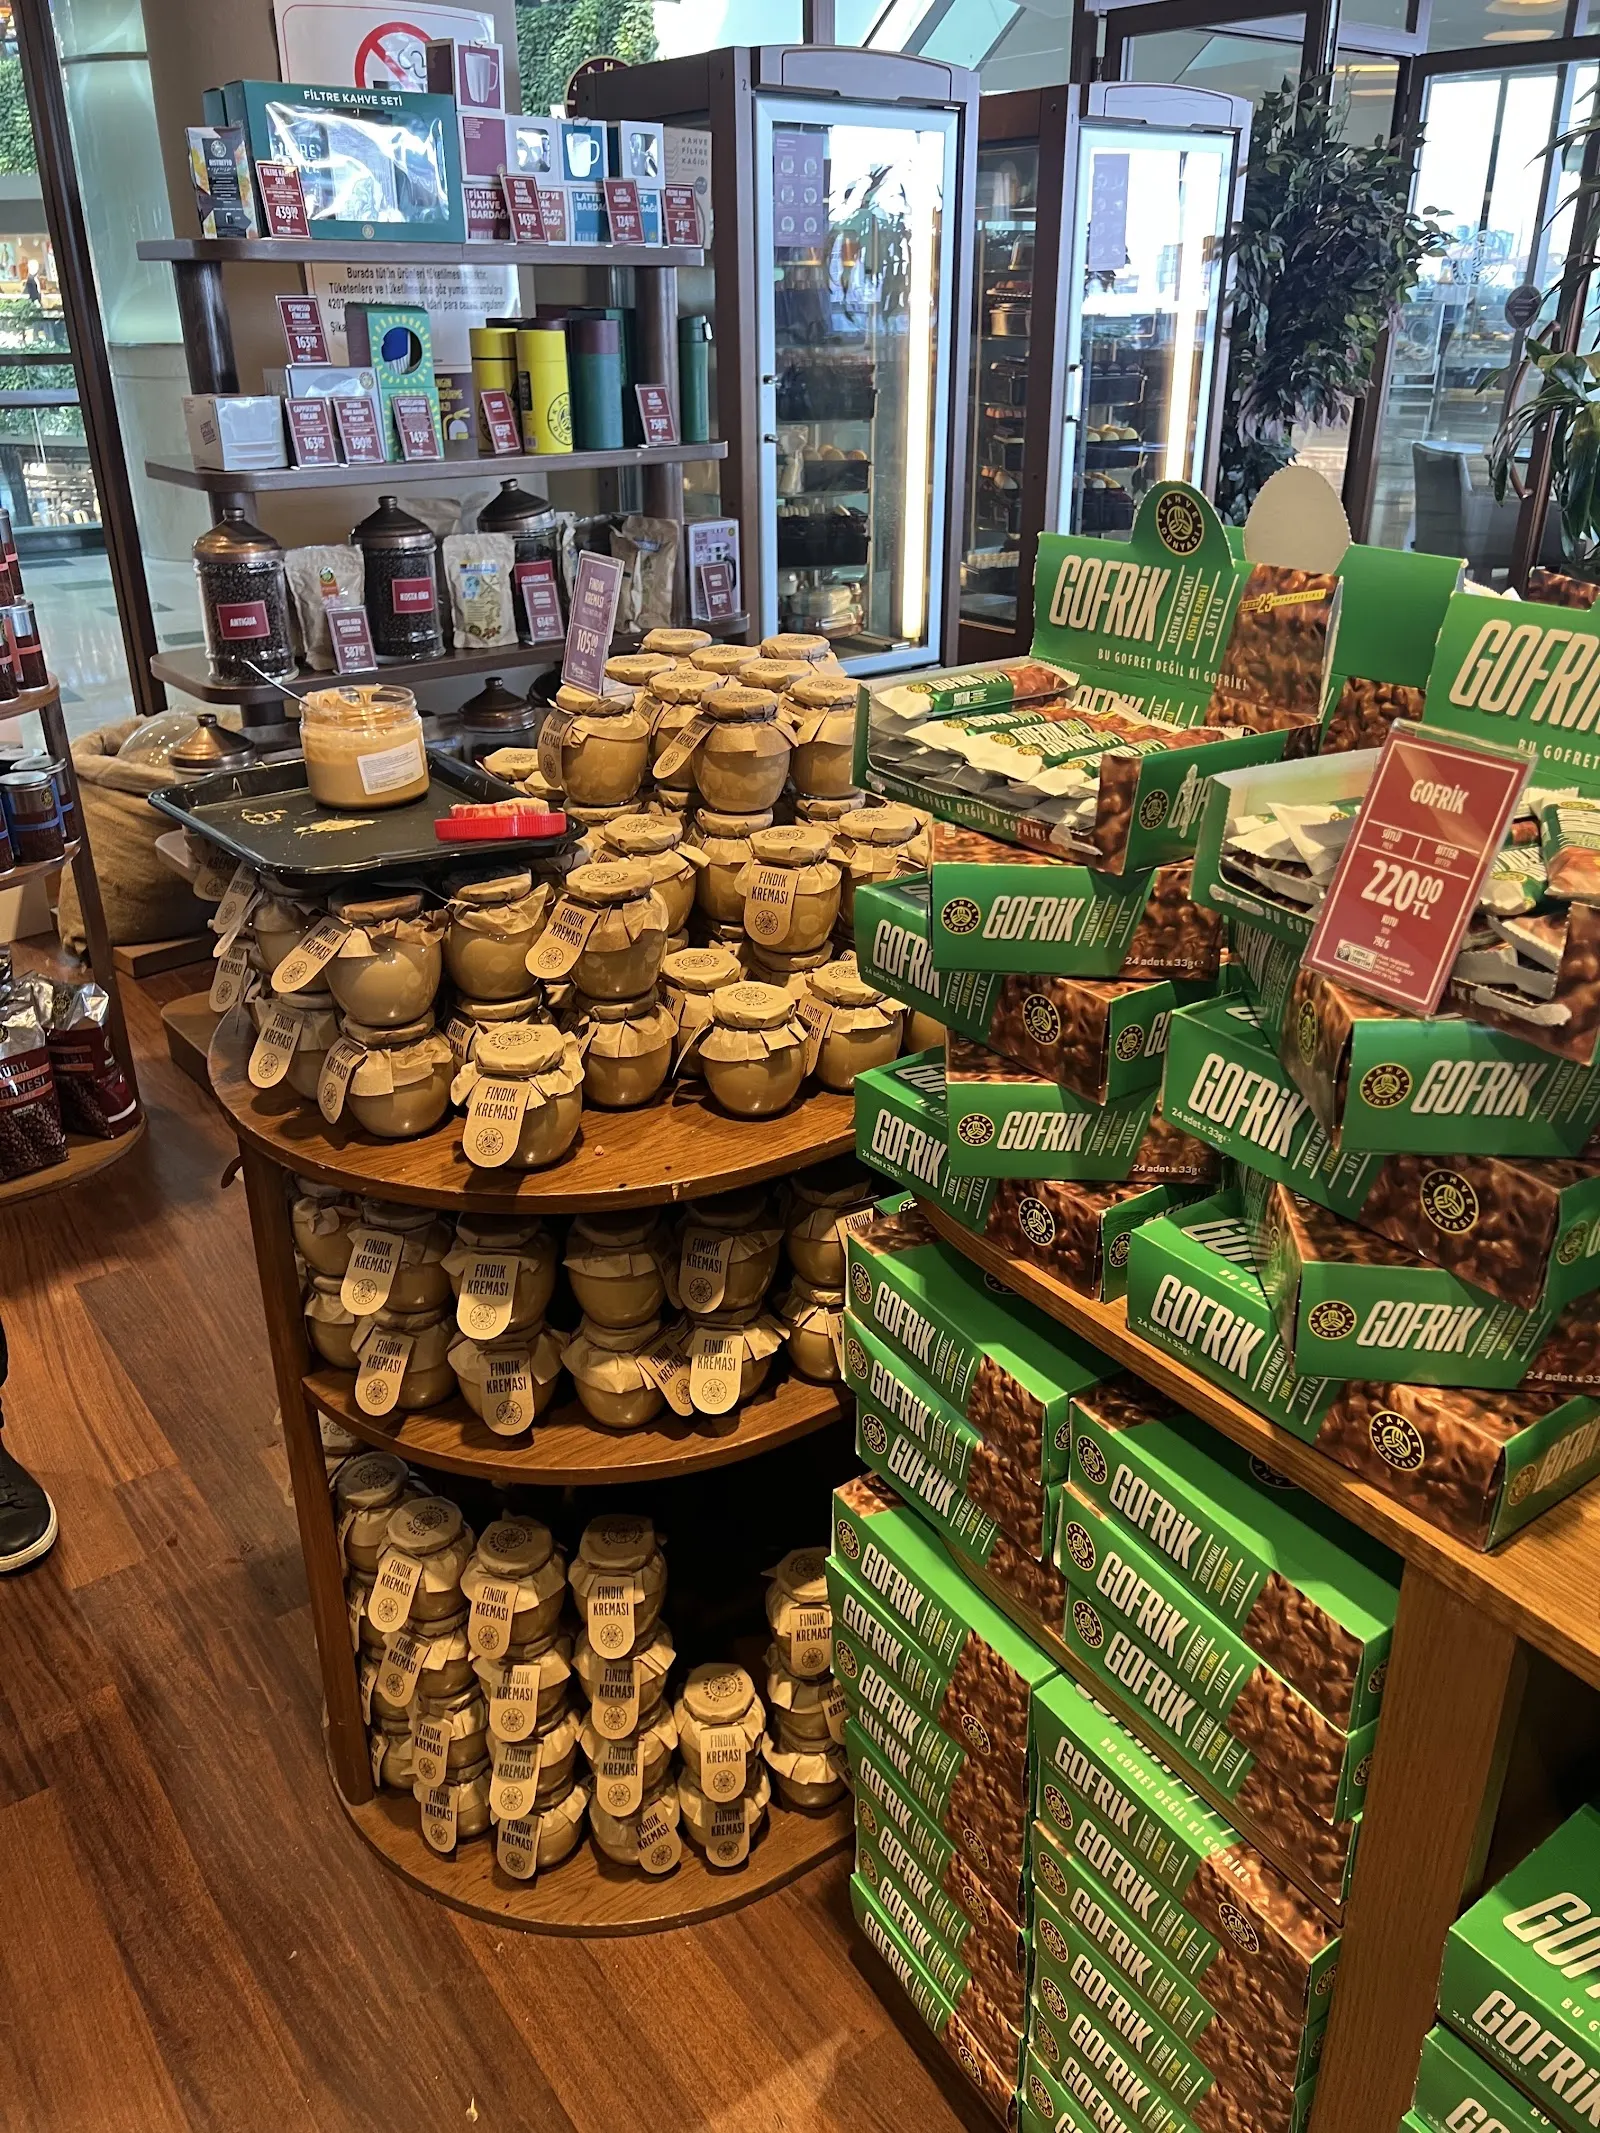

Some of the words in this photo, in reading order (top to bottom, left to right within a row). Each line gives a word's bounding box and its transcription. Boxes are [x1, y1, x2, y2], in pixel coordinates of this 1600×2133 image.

[304, 89, 338, 104] FİLTRE
[341, 92, 379, 105] KAHVE
[380, 94, 403, 107] SETİ
[682, 137, 708, 145] KAHVE
[682, 158, 708, 166] KAĞIDI
[469, 189, 497, 199] FİLTRE
[275, 205, 291, 219] 439
[518, 213, 531, 225] 143
[616, 215, 628, 227] 124
[347, 267, 373, 278] Burada
[329, 283, 372, 294] Tüketenlere
[376, 286, 383, 294] ve
[295, 336, 311, 349] 163
[303, 437, 318, 449] 163
[409, 432, 422, 443] 143
[1159, 495, 1198, 518] KAHVE
[1161, 526, 1198, 551] DÜNYASI
[1049, 555, 1171, 642] GOFRİK
[1257, 592, 1274, 613] 23
[1167, 614, 1181, 644] FISTIK
[1174, 575, 1195, 617] PARÇALI
[1186, 614, 1199, 642] FISTIK
[1195, 585, 1209, 614] EZMELİ
[1205, 598, 1225, 637] SÜTLÜ
[577, 629, 591, 653] 105
[1098, 648, 1111, 662] BU
[1115, 651, 1152, 670] GOFRET
[1156, 659, 1184, 677] DEĞİL
[1189, 667, 1201, 681] Kİ
[1204, 668, 1248, 691] GOFRİK!
[1517, 738, 1536, 756] BU
[1409, 779, 1469, 814] GOFRİK
[917, 789, 951, 811] GOFRET
[956, 803, 984, 822] DEĞİL
[989, 812, 999, 826] Kİ
[1004, 817, 1047, 842] GOFRİK!
[1381, 828, 1402, 843] SÜTLÜ
[758, 871, 788, 888] FINDIK
[1361, 859, 1420, 911] 220
[751, 887, 789, 905] KREMASI
[981, 895, 1086, 942] GOFRİK
[1381, 914, 1399, 927] KUTU
[1413, 901, 1432, 920] TL
[551, 922, 583, 948] KREMASI
[300, 937, 332, 962] KREMASI
[1125, 956, 1139, 966] 24
[1141, 958, 1165, 967] adet
[262, 1028, 293, 1050] KREMASI
[484, 1086, 518, 1102] FINDIK
[1411, 1059, 1548, 1116] GOFRİK
[474, 1102, 519, 1120] KREMASI
[1171, 1107, 1185, 1119] 24
[1187, 1052, 1308, 1158] GOFRİK
[996, 1111, 1093, 1151] GOFRİK
[871, 1108, 948, 1188] GOFRİK
[1132, 1164, 1146, 1172] 24
[1147, 1164, 1171, 1173] adet
[363, 1239, 394, 1256] FINDIK
[354, 1253, 393, 1274] KREMASI
[474, 1263, 506, 1278] FINDIK
[686, 1254, 723, 1274] KREMASI
[466, 1280, 509, 1297] KREMASI
[873, 1281, 937, 1366] GOFRİK
[1137, 1316, 1150, 1330] 24
[1151, 1273, 1264, 1380] GOFRİK
[1356, 1300, 1486, 1353] GOFRİK
[375, 1339, 403, 1357] FINDIK
[703, 1339, 733, 1354] FINDIK
[366, 1354, 401, 1374] KREMASI
[490, 1359, 521, 1377] FINDIK
[697, 1354, 736, 1372] KREMASI
[486, 1376, 527, 1394] KREMASI
[1526, 1370, 1544, 1381] 24
[1545, 1371, 1571, 1382] adet
[869, 1359, 930, 1443] GOFRİK
[1108, 1463, 1203, 1571] GOFRİK
[388, 1559, 413, 1580] FINDIK
[380, 1574, 411, 1597] KREMASI
[597, 1586, 625, 1599] FINDIK
[860, 1542, 925, 1628] GOFRİK
[482, 1586, 509, 1605] FINDIK
[1095, 1551, 1189, 1658] GOFRİK
[475, 1602, 509, 1622] KREMASI
[593, 1603, 629, 1616] KREMASI
[799, 1612, 825, 1627] FINDIK
[842, 1594, 904, 1674] GOFRİK
[387, 1650, 417, 1674] KREMASI
[502, 1669, 531, 1685] FINDIK
[604, 1668, 632, 1683] FINDIK
[1103, 1630, 1197, 1739] GOFRİK
[496, 1685, 533, 1702] KREMASI
[599, 1683, 635, 1699] KREMASI
[857, 1664, 922, 1746] GOFRİK
[418, 1723, 441, 1740] FINDIK
[710, 1734, 737, 1747] FINDIK
[414, 1737, 444, 1757] KREMASI
[505, 1747, 532, 1763] FINDIK
[706, 1750, 742, 1765] KREMASI
[498, 1764, 533, 1780] KREMASI
[603, 1762, 638, 1777] KREMASI
[1054, 1736, 1137, 1836] GOFRİK
[425, 1803, 453, 1823] KREMASI
[1099, 1737, 1115, 1754] BU
[1117, 1750, 1156, 1791] GOFRET
[1154, 1787, 1187, 1823] DEĞİL
[1187, 1817, 1204, 1835] Kİ
[1201, 1835, 1251, 1884] GOFRİK!
[637, 1825, 671, 1851] KREMASI
[711, 1822, 745, 1837] KREMASI
[501, 1833, 533, 1852] KREMASI
[878, 1826, 933, 1907] GOFRİK
[1074, 1819, 1160, 1921] GOFRİK
[878, 1875, 932, 1958] GOFRİK
[1070, 1887, 1153, 1987] GOFRİK
[863, 1912, 914, 1991] GOFRİK
[1070, 1954, 1154, 2053] GOFRİK
[1561, 1997, 1584, 2018] BU
[1452, 2010, 1466, 2025] 24
[1465, 2020, 1490, 2044] adet
[1069, 2014, 1150, 2113] GOFRİK
